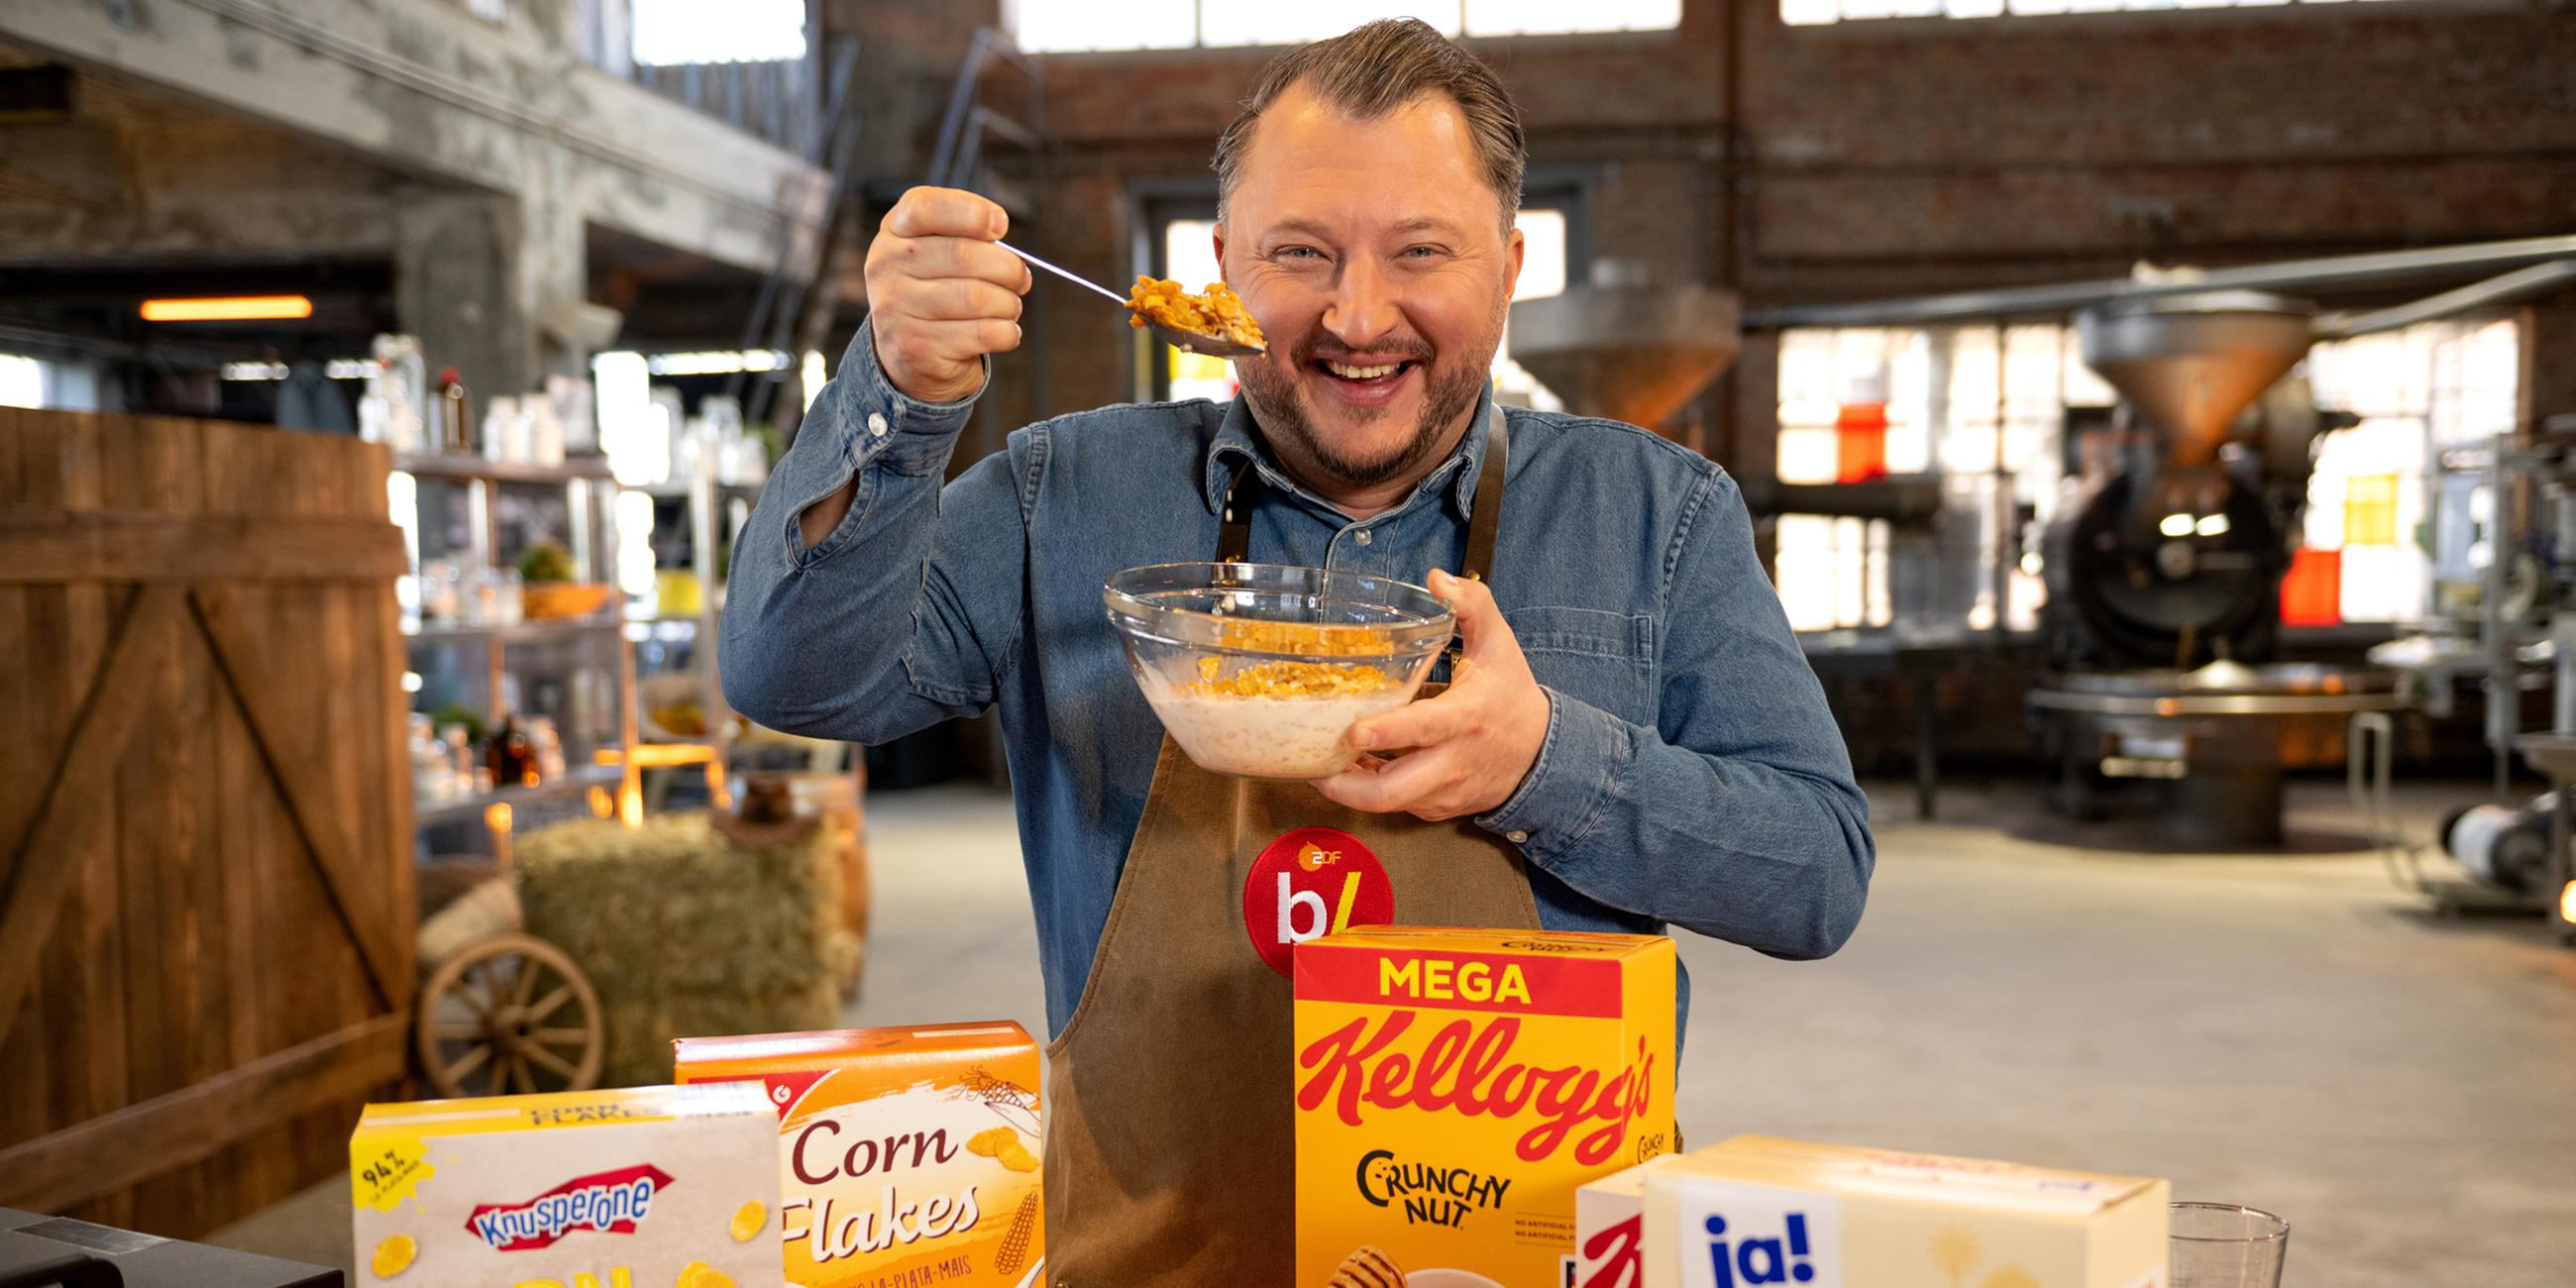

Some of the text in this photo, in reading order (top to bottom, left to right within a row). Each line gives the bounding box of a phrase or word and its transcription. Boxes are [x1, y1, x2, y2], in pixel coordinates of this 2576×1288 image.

[1311, 850, 1342, 865] ZDF
[1379, 957, 1533, 1006] MEGA
[1297, 1010, 1657, 1166] Kellogg's
[362, 1148, 405, 1187] 94%
[793, 1119, 959, 1185] Corn
[1356, 1149, 1512, 1209] CRUNCHY
[480, 1178, 651, 1245] Knusperone
[782, 1184, 981, 1263] Flakes
[1404, 1196, 1472, 1229] NUT
[1528, 1220, 1567, 1231] ARTIFICIAL
[1528, 1232, 1567, 1241] ARTIFICIAL
[1705, 1213, 1814, 1288] ja!
